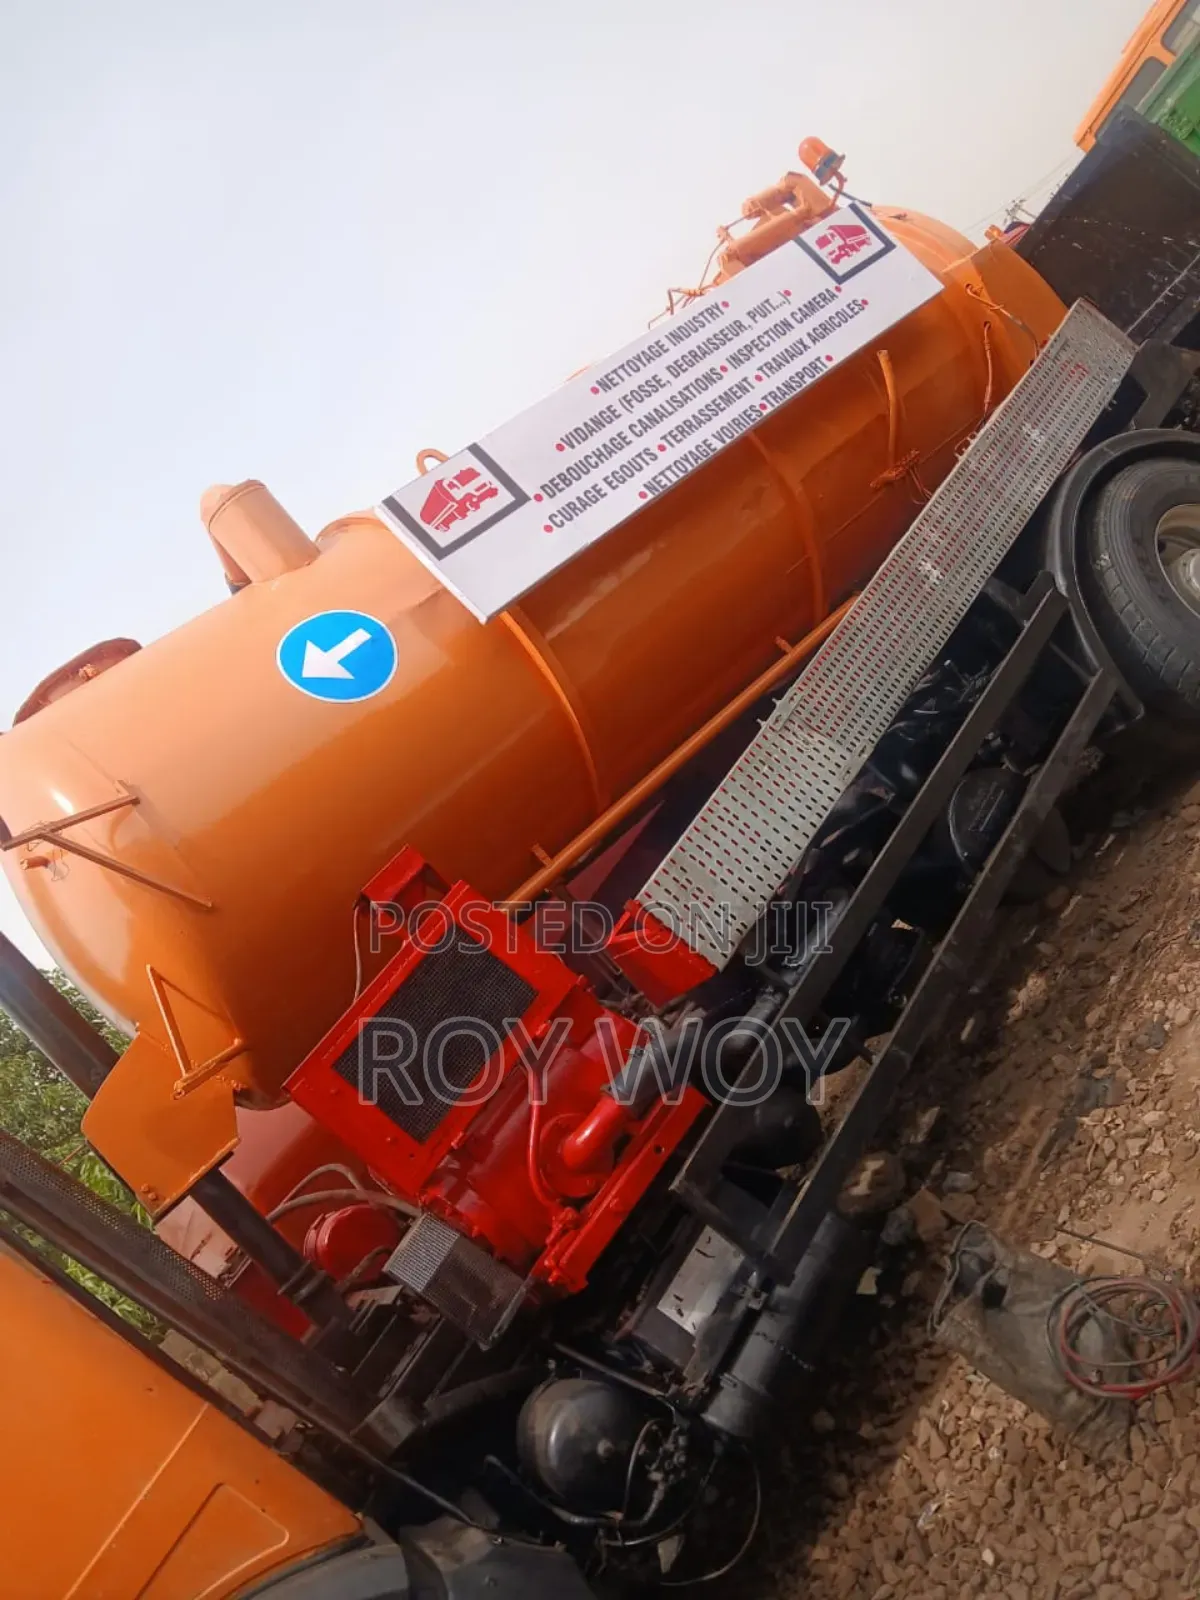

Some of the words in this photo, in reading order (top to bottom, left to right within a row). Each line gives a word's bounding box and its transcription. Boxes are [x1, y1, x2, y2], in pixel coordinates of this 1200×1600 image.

[540, 432, 632, 499] DEBOUCHAGE
[628, 367, 724, 437] CANALISATIONS
[726, 318, 795, 370] INSPECTION
[790, 288, 838, 325] CAMERA
[548, 487, 607, 529] CURAGE
[603, 447, 658, 491] EGOUTS
[660, 377, 756, 448] TERRASSEMENT
[757, 338, 809, 380] TRAVAUX
[807, 299, 865, 345] AGRICOLES
[560, 405, 622, 450] VIDANGE
[618, 374, 672, 414] (FOSSE,
[666, 320, 751, 378] DEGRAISSEUR,
[596, 340, 669, 393] NETTOYAGE
[665, 302, 725, 347] INDUSTRY
[643, 439, 718, 496] NETTOYAGE
[712, 404, 763, 445] VOIRIES
[761, 356, 828, 408] TRANSPORT
